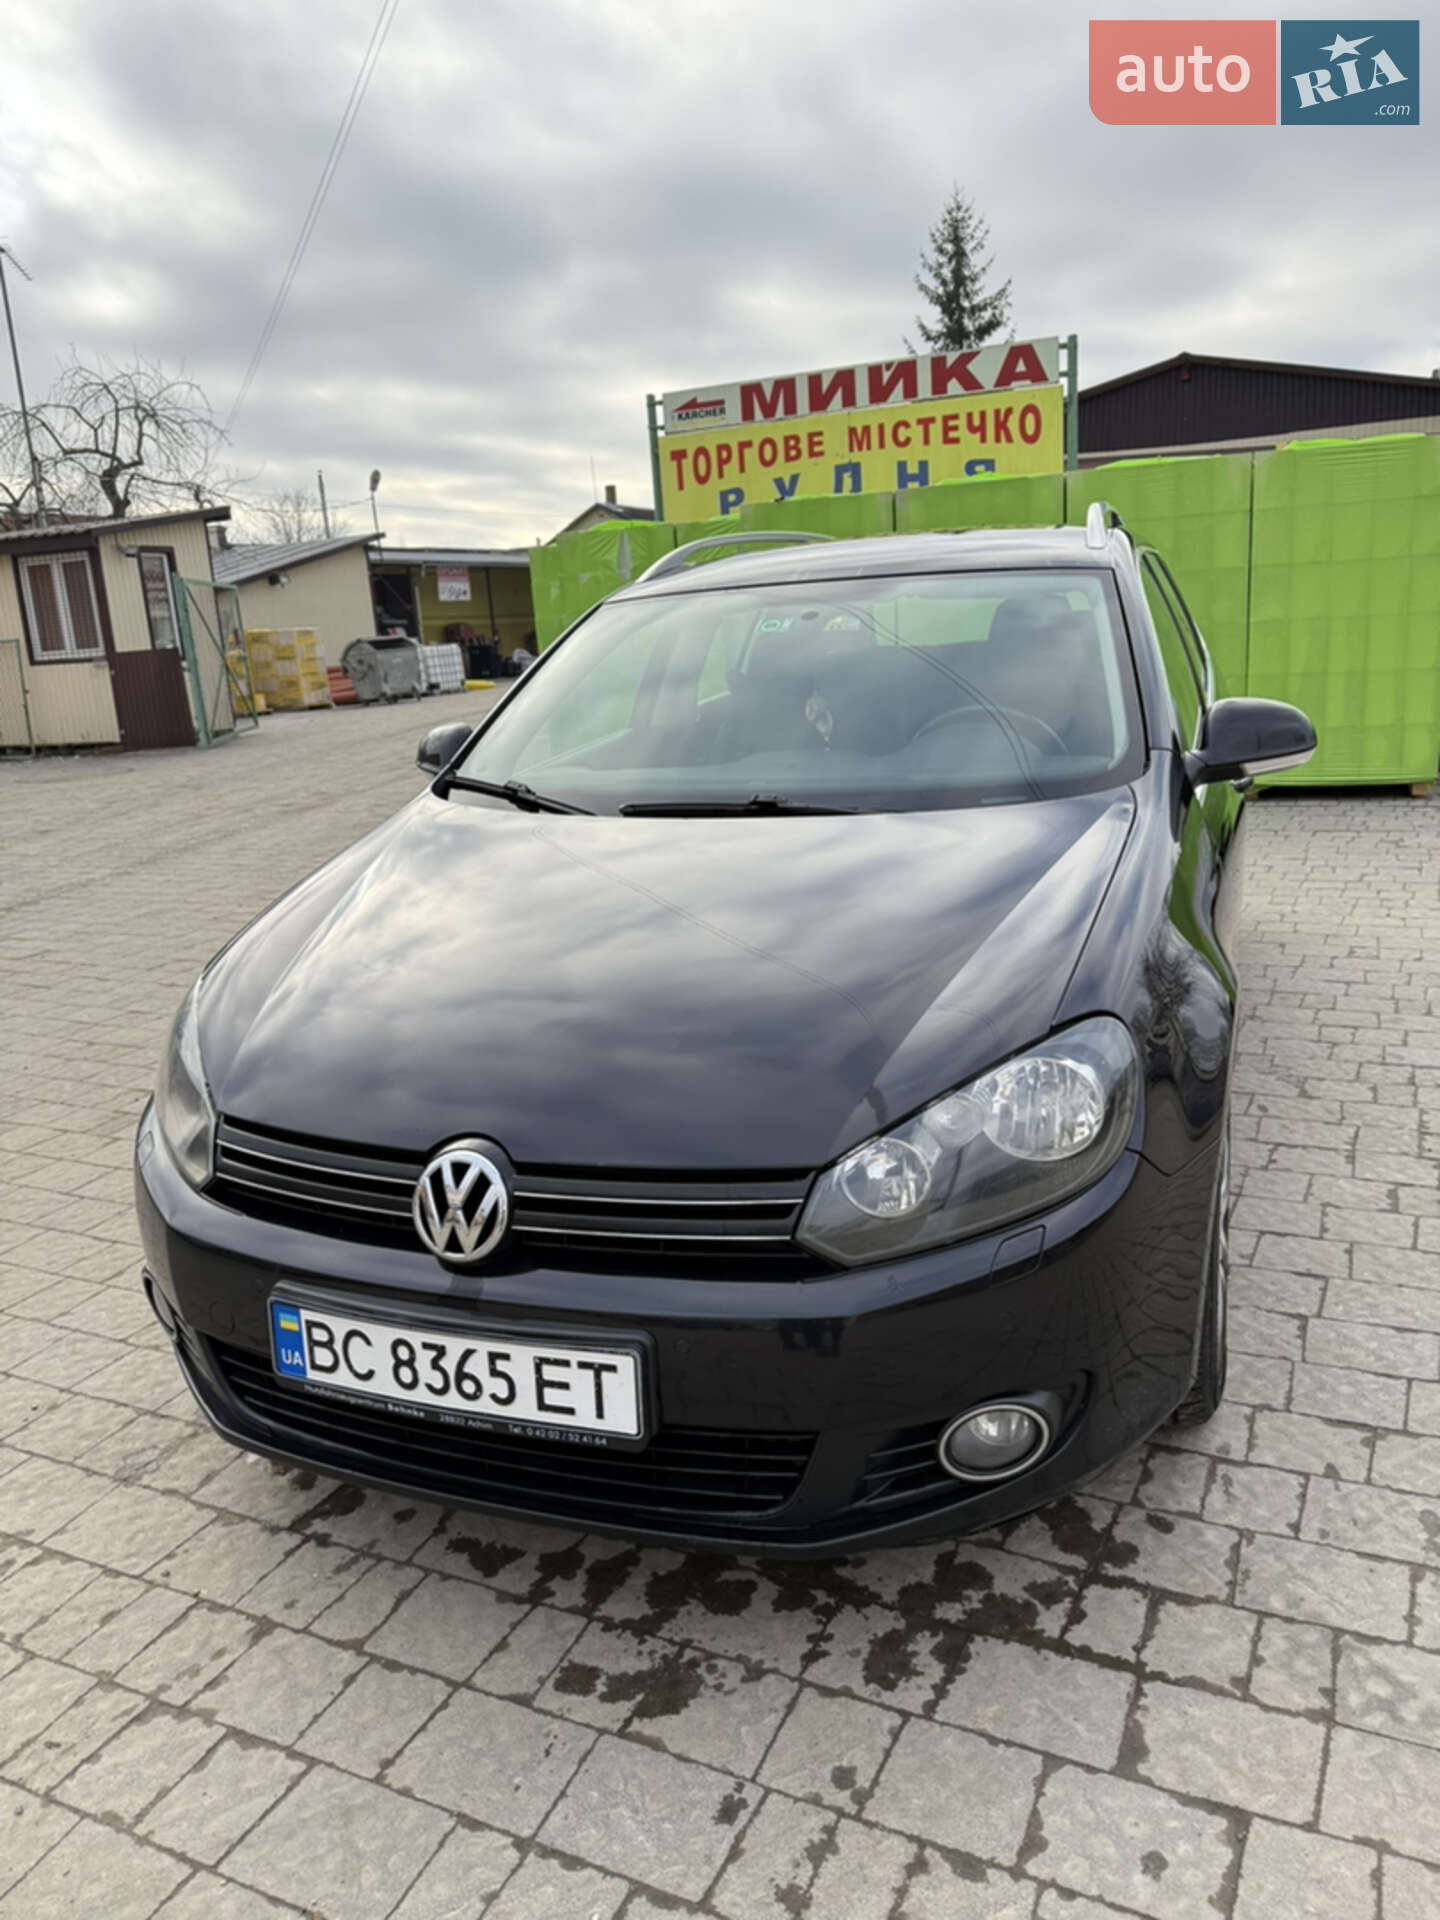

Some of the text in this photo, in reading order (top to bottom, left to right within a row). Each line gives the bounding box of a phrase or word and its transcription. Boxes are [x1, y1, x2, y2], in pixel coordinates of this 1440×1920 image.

[740, 343, 1050, 423] МИЙКА
[669, 403, 1042, 491] ТОРГОВЕ МІСТЕЧКО
[281, 1348, 304, 1368] UA
[304, 1318, 617, 1420] BC 8365 ET
